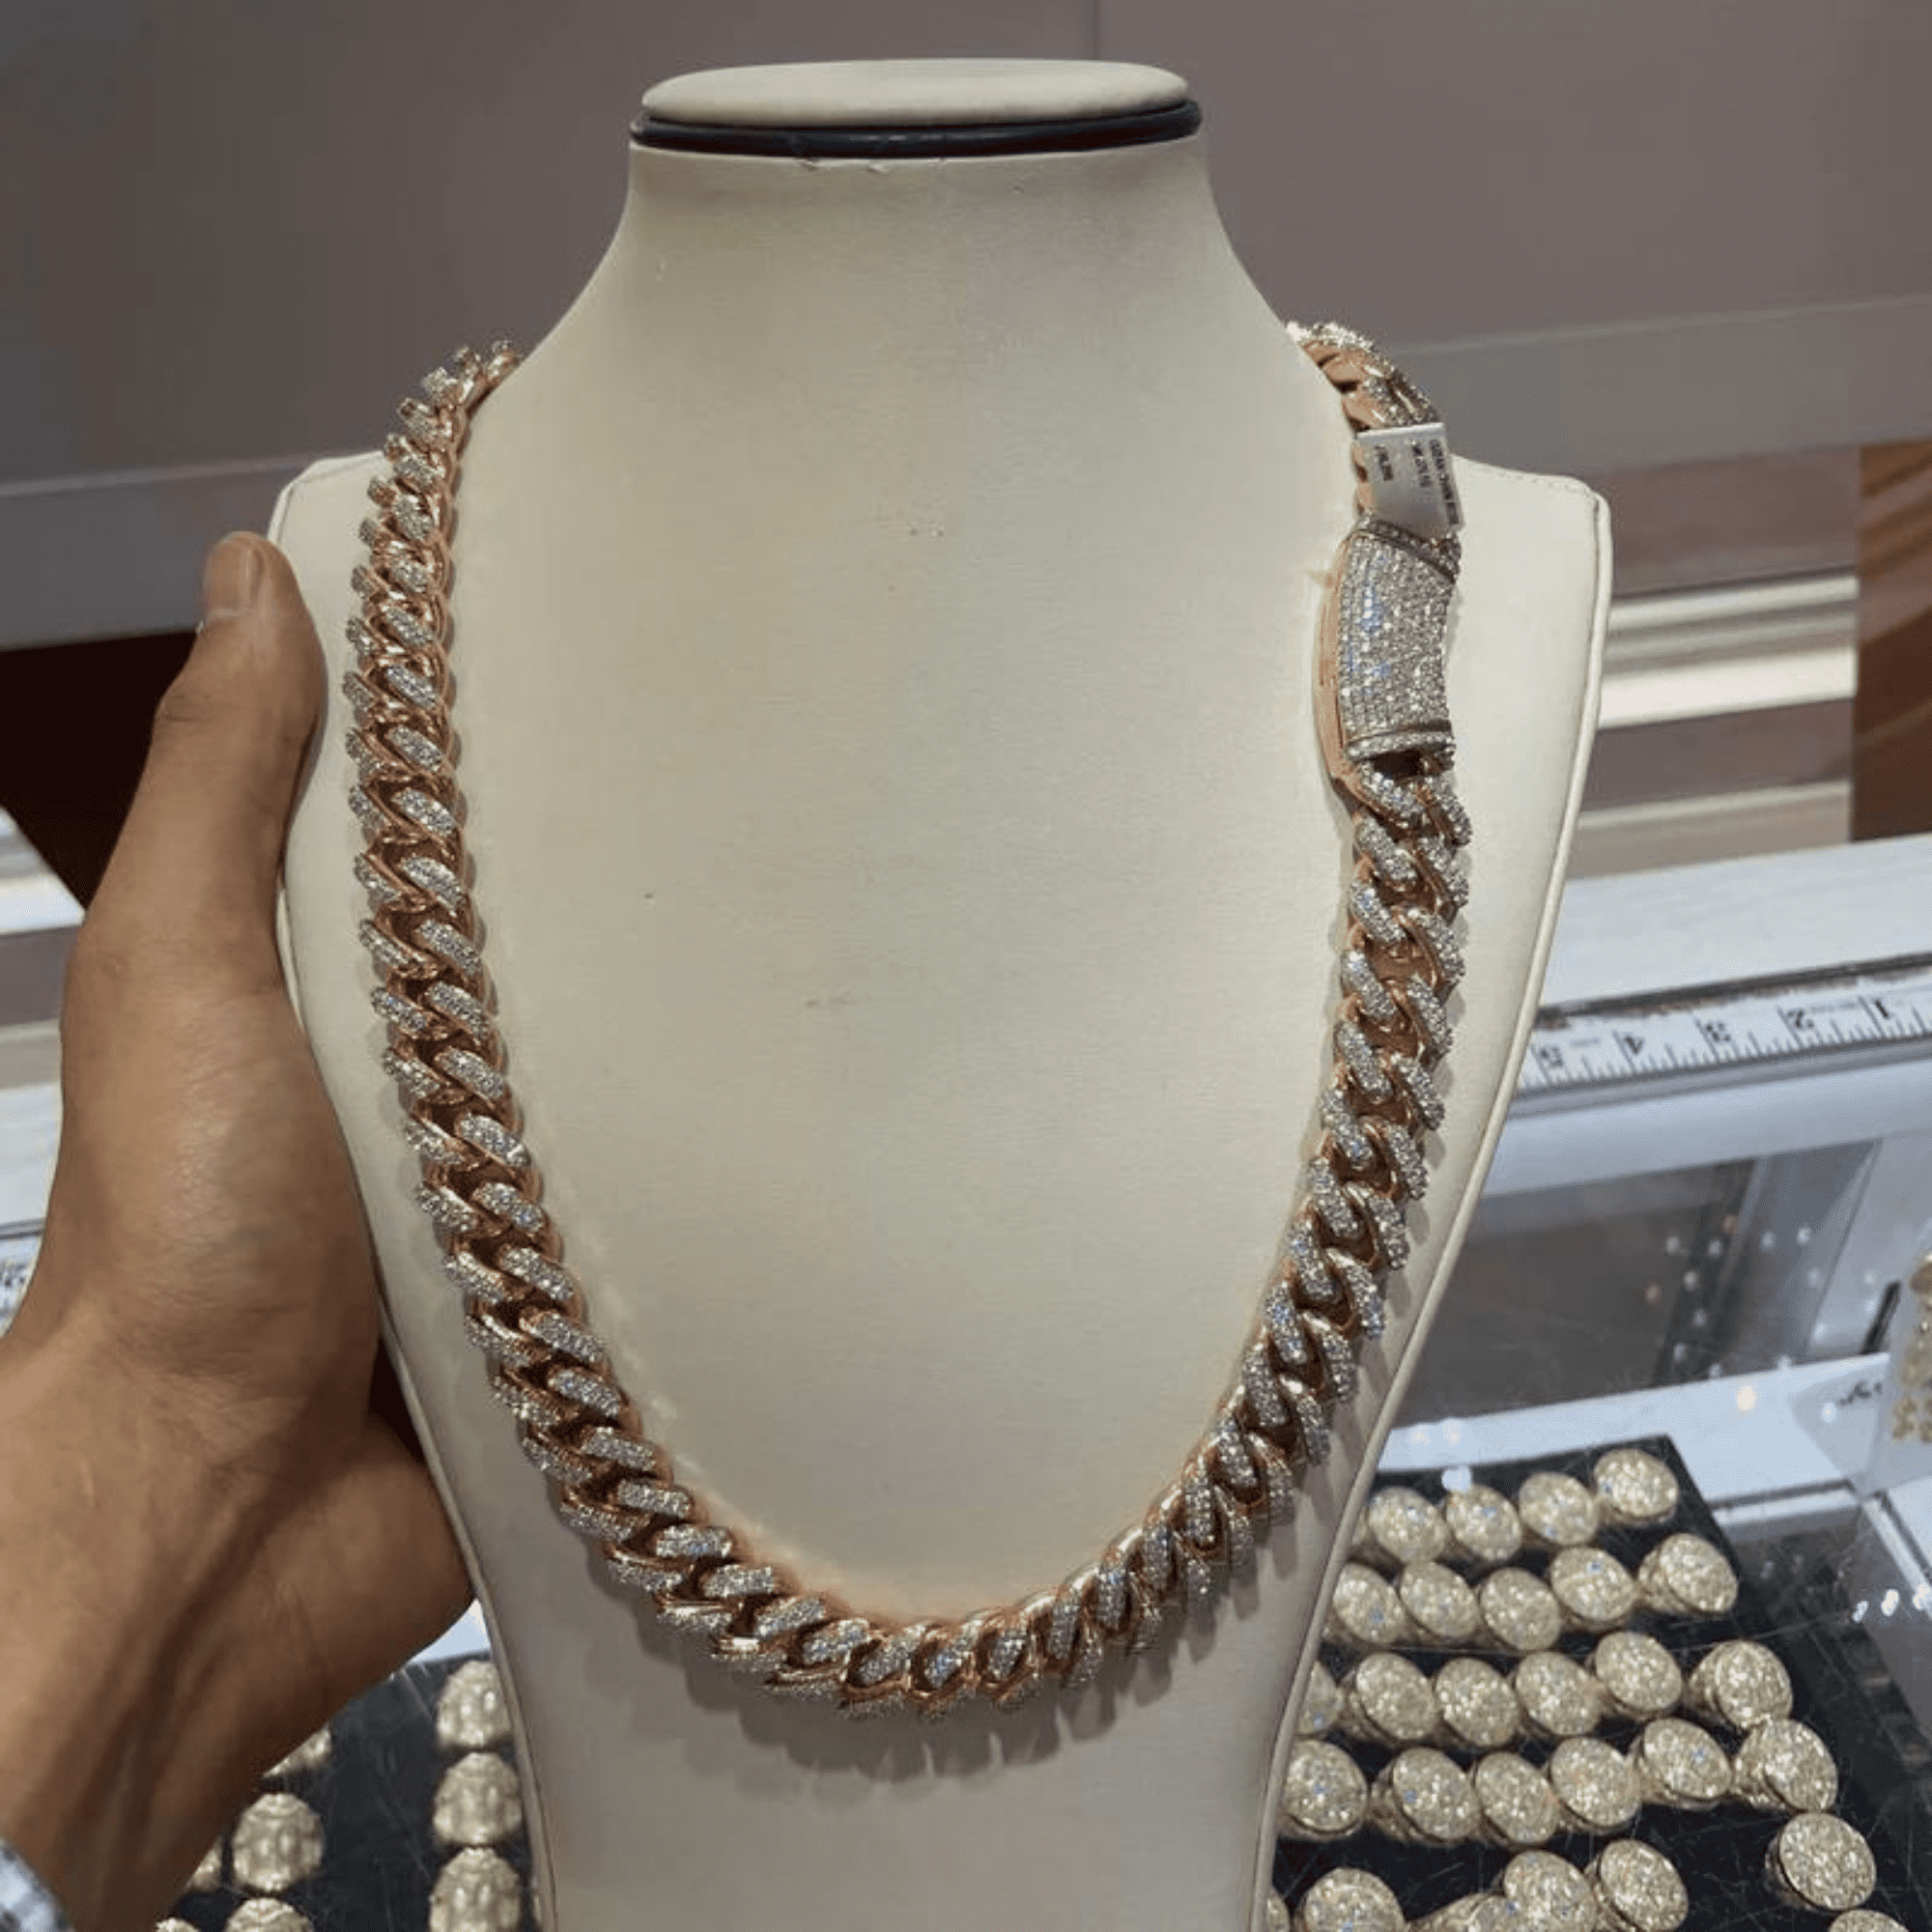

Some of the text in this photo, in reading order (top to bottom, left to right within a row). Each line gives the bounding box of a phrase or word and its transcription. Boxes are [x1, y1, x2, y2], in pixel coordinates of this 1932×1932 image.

[1786, 1007, 1814, 1029] 2
[1873, 997, 1890, 1019] 1
[1705, 1020, 1732, 1042] 3
[1622, 1032, 1646, 1056] 4
[1539, 1044, 1564, 1067] 5
